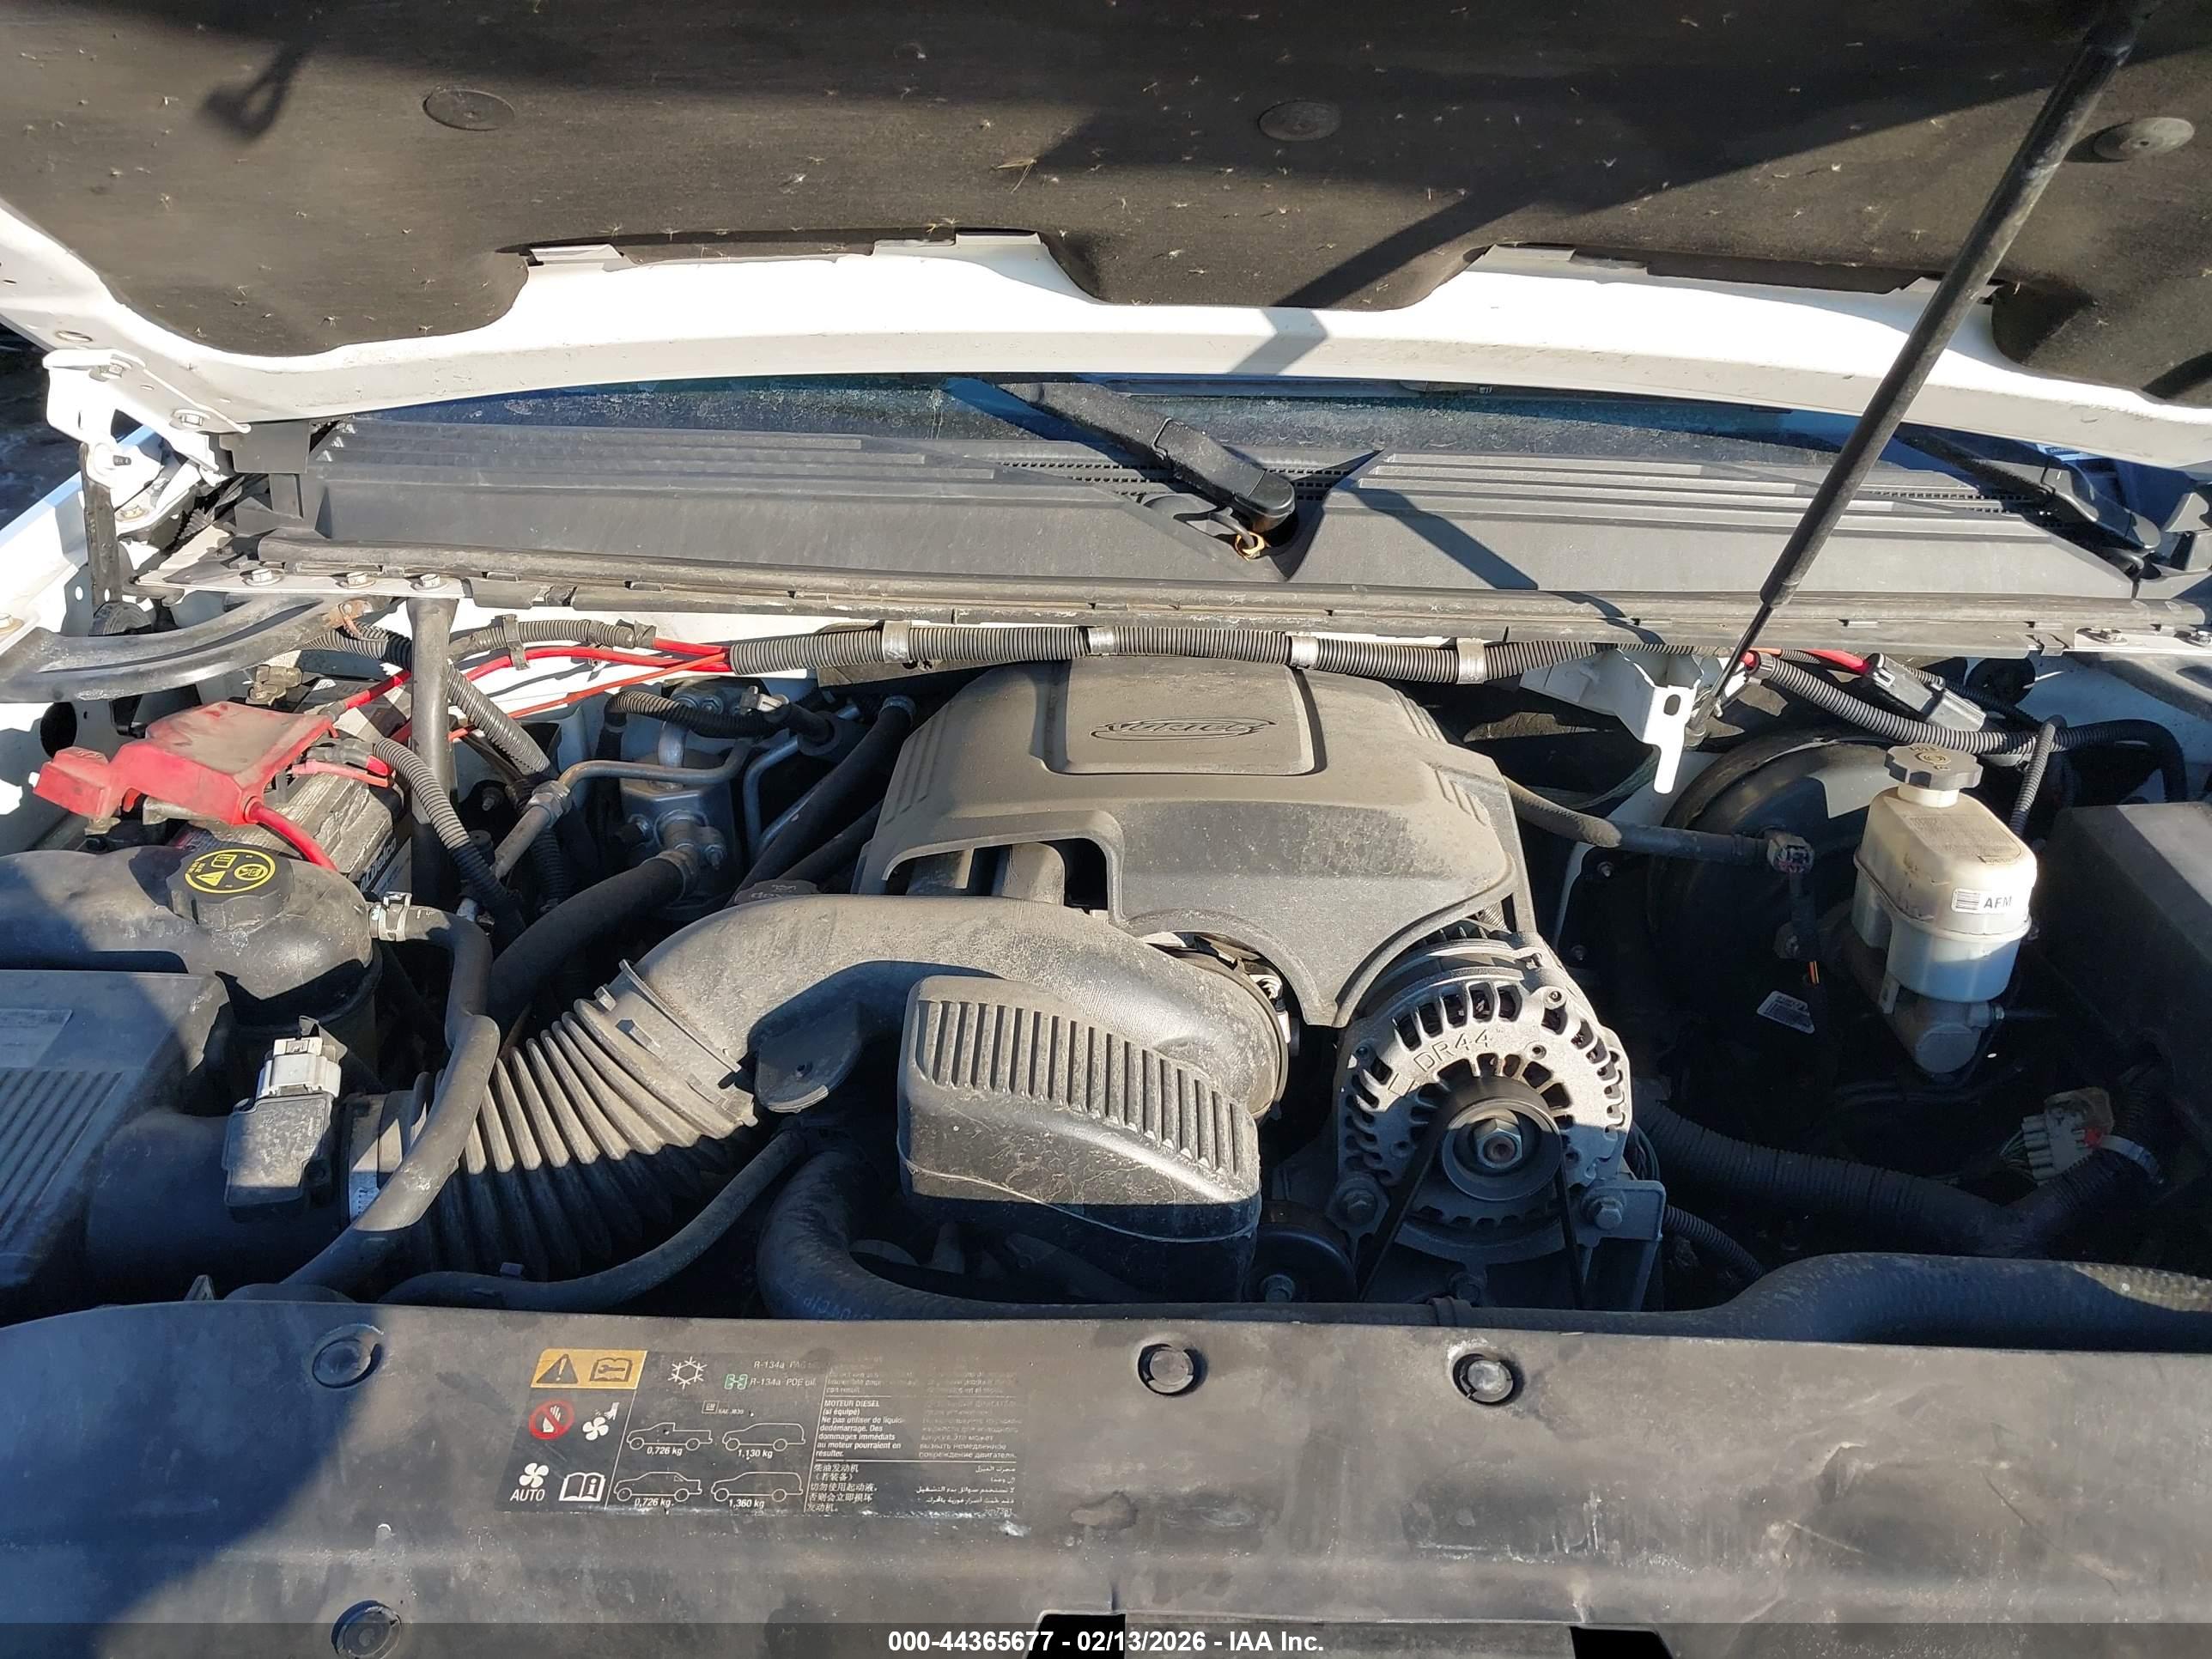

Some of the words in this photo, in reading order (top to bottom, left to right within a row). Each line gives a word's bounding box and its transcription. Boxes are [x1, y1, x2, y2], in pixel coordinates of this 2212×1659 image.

[1983, 896, 2012, 908] AFM
[1413, 1028, 1490, 1073] DR44
[754, 1360, 785, 1369] R-134a
[750, 1377, 781, 1386] R-134a
[786, 1377, 804, 1386] POE
[854, 1442, 891, 1450] pourraient
[646, 1446, 669, 1456] 0,726
[672, 1447, 683, 1457] kg
[738, 1449, 761, 1458] 1,130
[763, 1450, 773, 1459] kg
[509, 1488, 546, 1502] AUTO
[634, 1498, 658, 1508] 0,726
[729, 1498, 752, 1508] 1,360
[754, 1499, 765, 1509] kg
